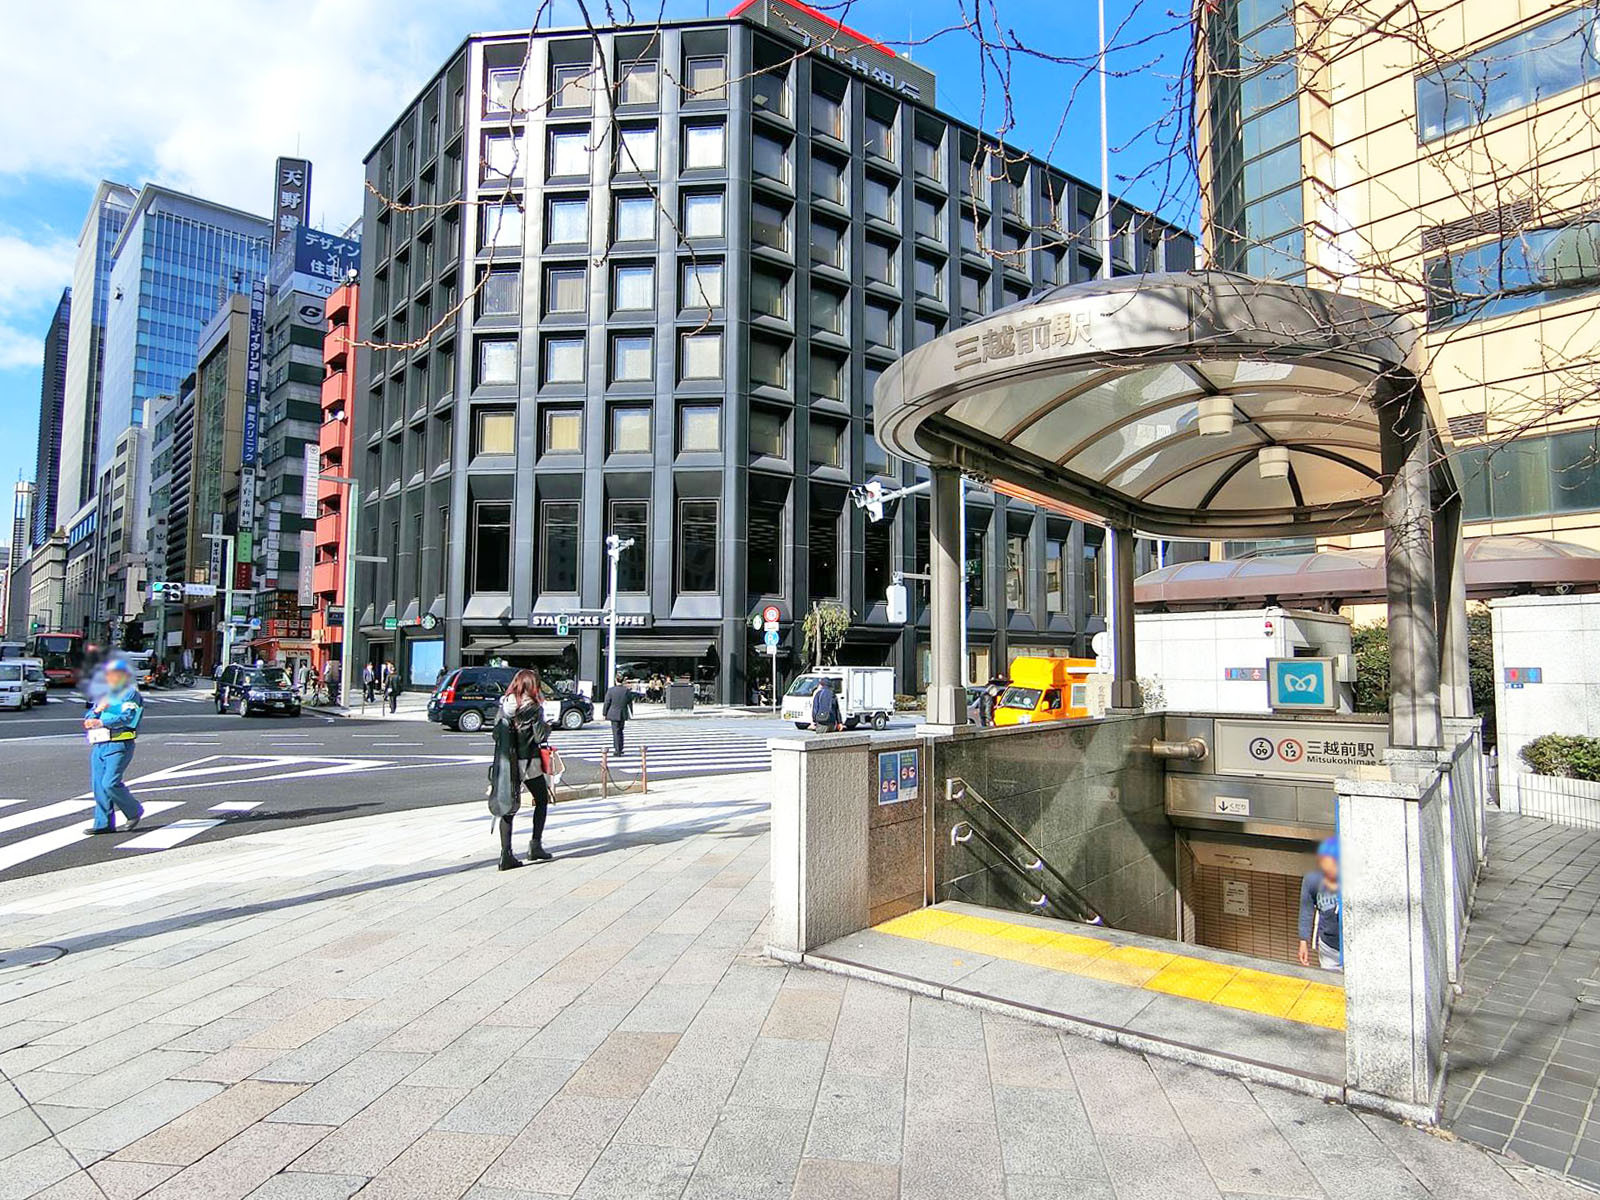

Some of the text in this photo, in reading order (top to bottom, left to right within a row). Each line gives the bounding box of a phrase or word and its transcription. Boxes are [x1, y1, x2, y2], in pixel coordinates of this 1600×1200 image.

[305, 233, 360, 257] デザイン
[954, 311, 1092, 372] 三越前駅
[533, 615, 645, 625] STAUCKS CFFEE
[1255, 748, 1268, 756] 09
[1284, 749, 1297, 757] 12
[1307, 740, 1375, 758] 三越前駅
[1307, 756, 1376, 766] Mitsukoshimae
